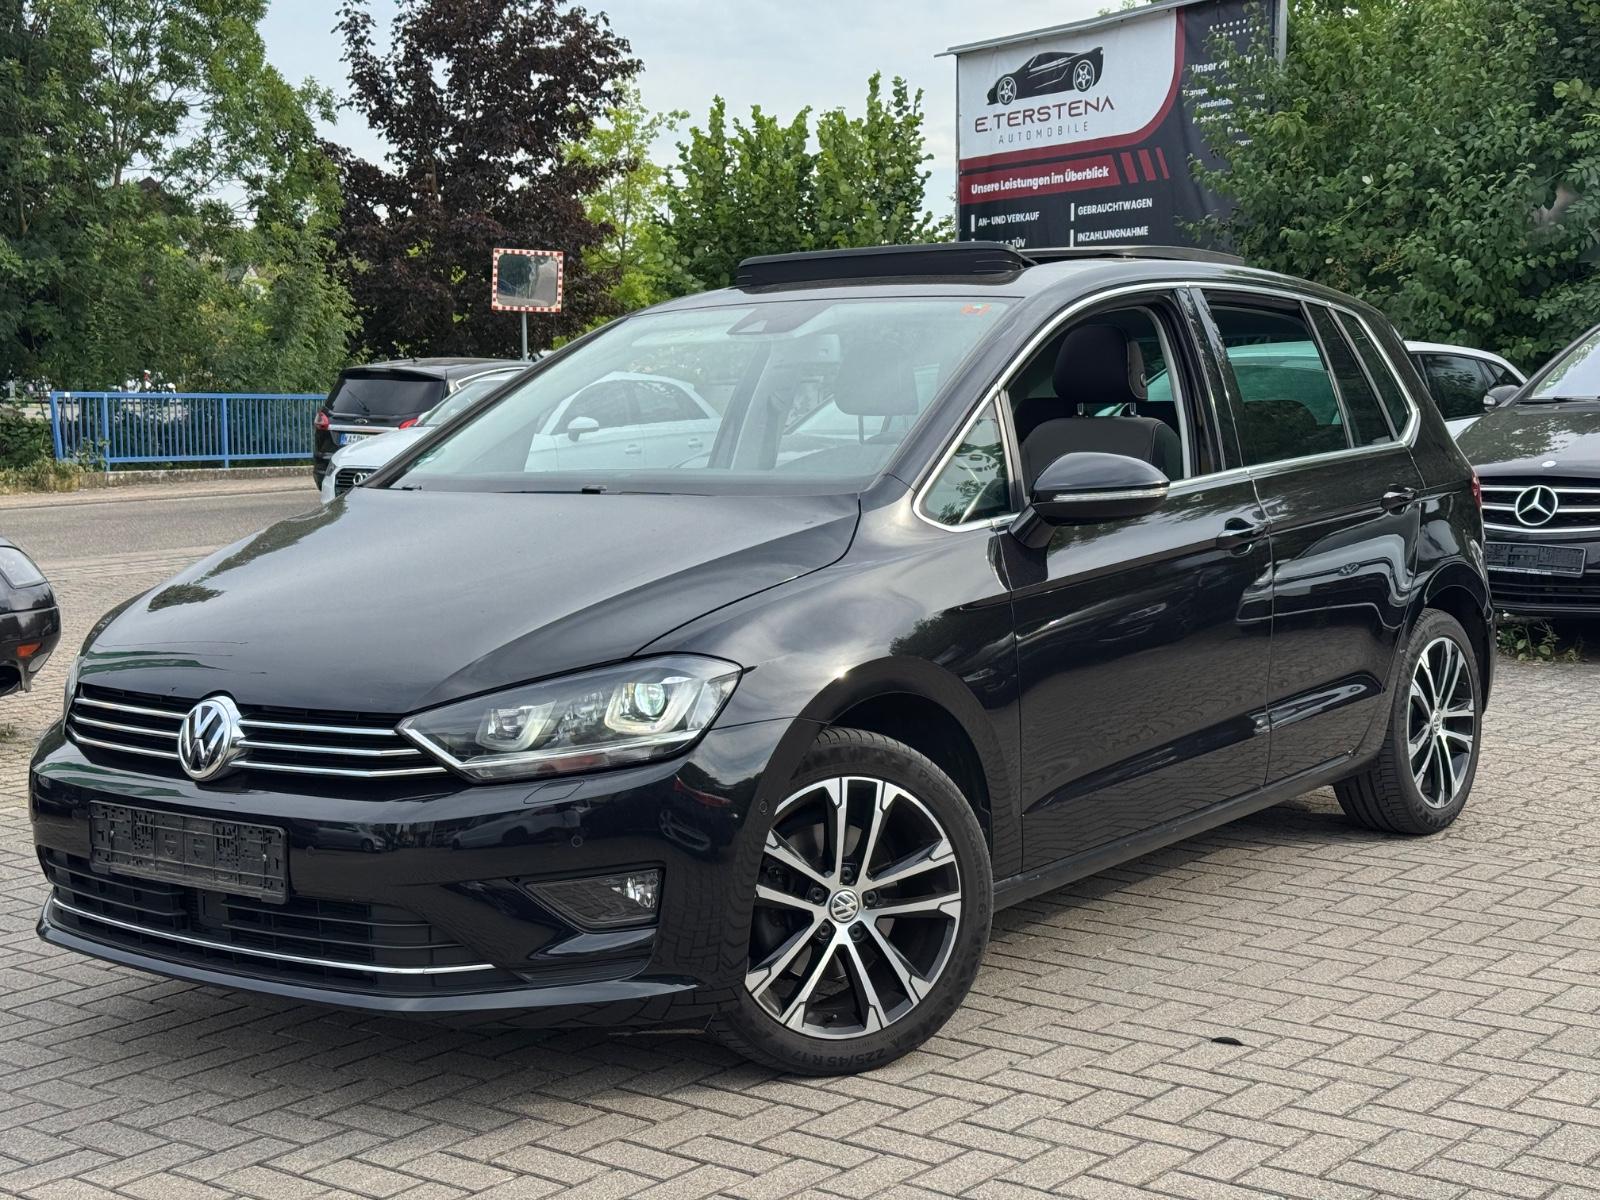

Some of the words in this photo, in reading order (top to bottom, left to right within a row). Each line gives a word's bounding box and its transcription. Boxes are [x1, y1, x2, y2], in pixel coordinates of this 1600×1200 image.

[1192, 62, 1217, 74] Unser
[998, 121, 1088, 144] AUTOMOBILE
[971, 182, 1000, 194] Unsere
[1000, 175, 1050, 190] Leistungen
[1051, 172, 1064, 183] im
[1064, 165, 1109, 183] Überblick
[1078, 198, 1153, 215] GEBRAUCHTWAGEN
[978, 218, 990, 227] AN-
[991, 215, 1006, 225] UND
[1007, 211, 1040, 224] VERKAUF
[1077, 226, 1149, 242] INZAHLUNGNAHME
[1012, 237, 1026, 248] TÜV
